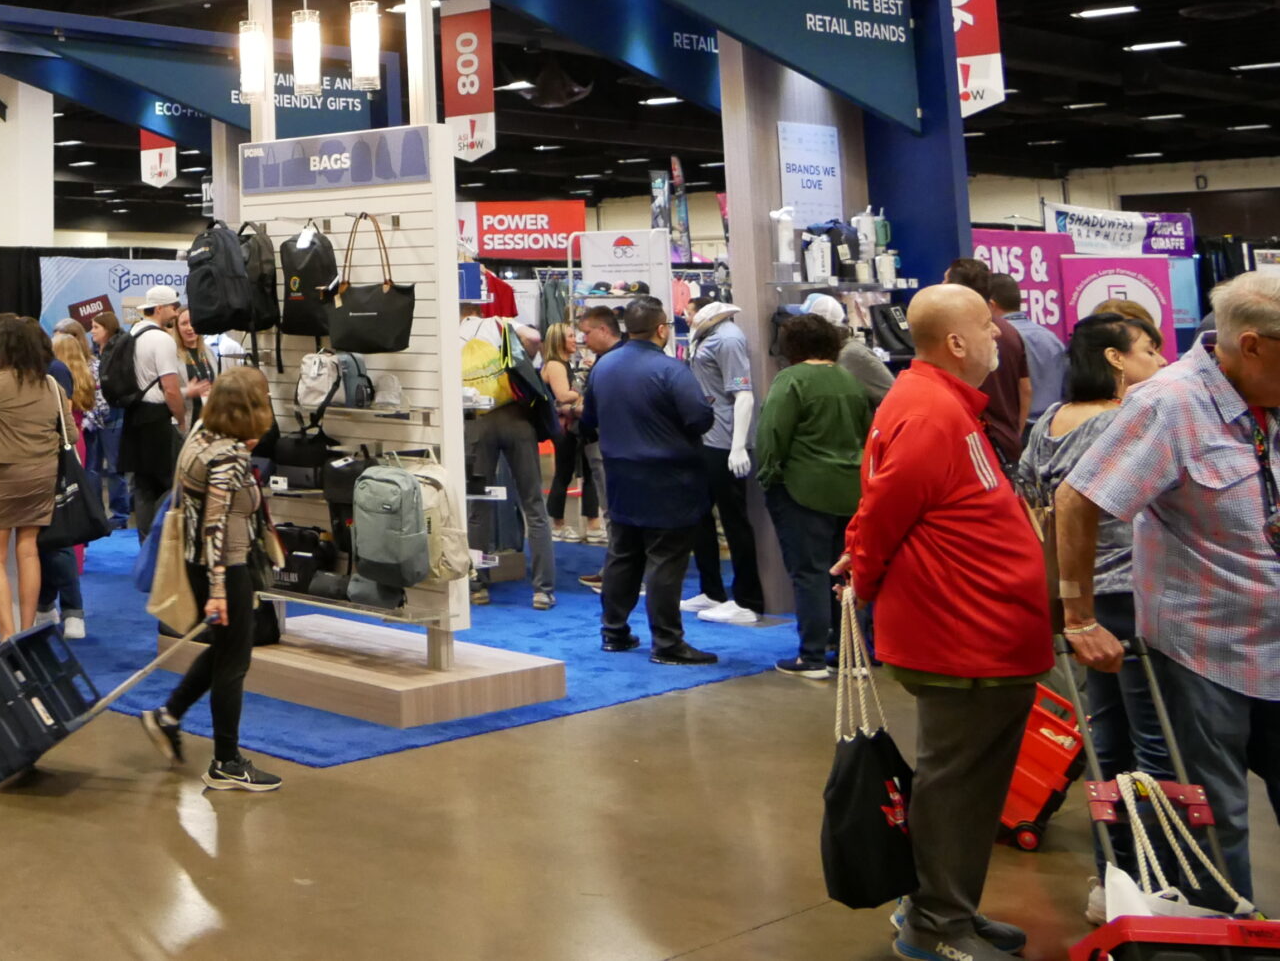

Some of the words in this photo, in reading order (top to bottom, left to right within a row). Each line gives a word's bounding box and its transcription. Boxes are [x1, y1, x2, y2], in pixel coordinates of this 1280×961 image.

[805, 13, 852, 36] RETAIL
[854, 20, 907, 43] BRANDS
[673, 32, 719, 53] RETAIL
[455, 32, 480, 95] 800
[327, 97, 362, 111] GIFTS
[458, 140, 484, 152] SHOW
[309, 152, 351, 171] BAGS
[785, 163, 821, 176] BRANDS
[822, 166, 836, 177] WE
[801, 179, 823, 190] LOVE
[1195, 175, 1208, 190] D
[482, 214, 549, 230] POWER
[482, 233, 569, 250] SESSIONS
[1151, 237, 1186, 250] GIRAFFE
[1030, 245, 1049, 282] &
